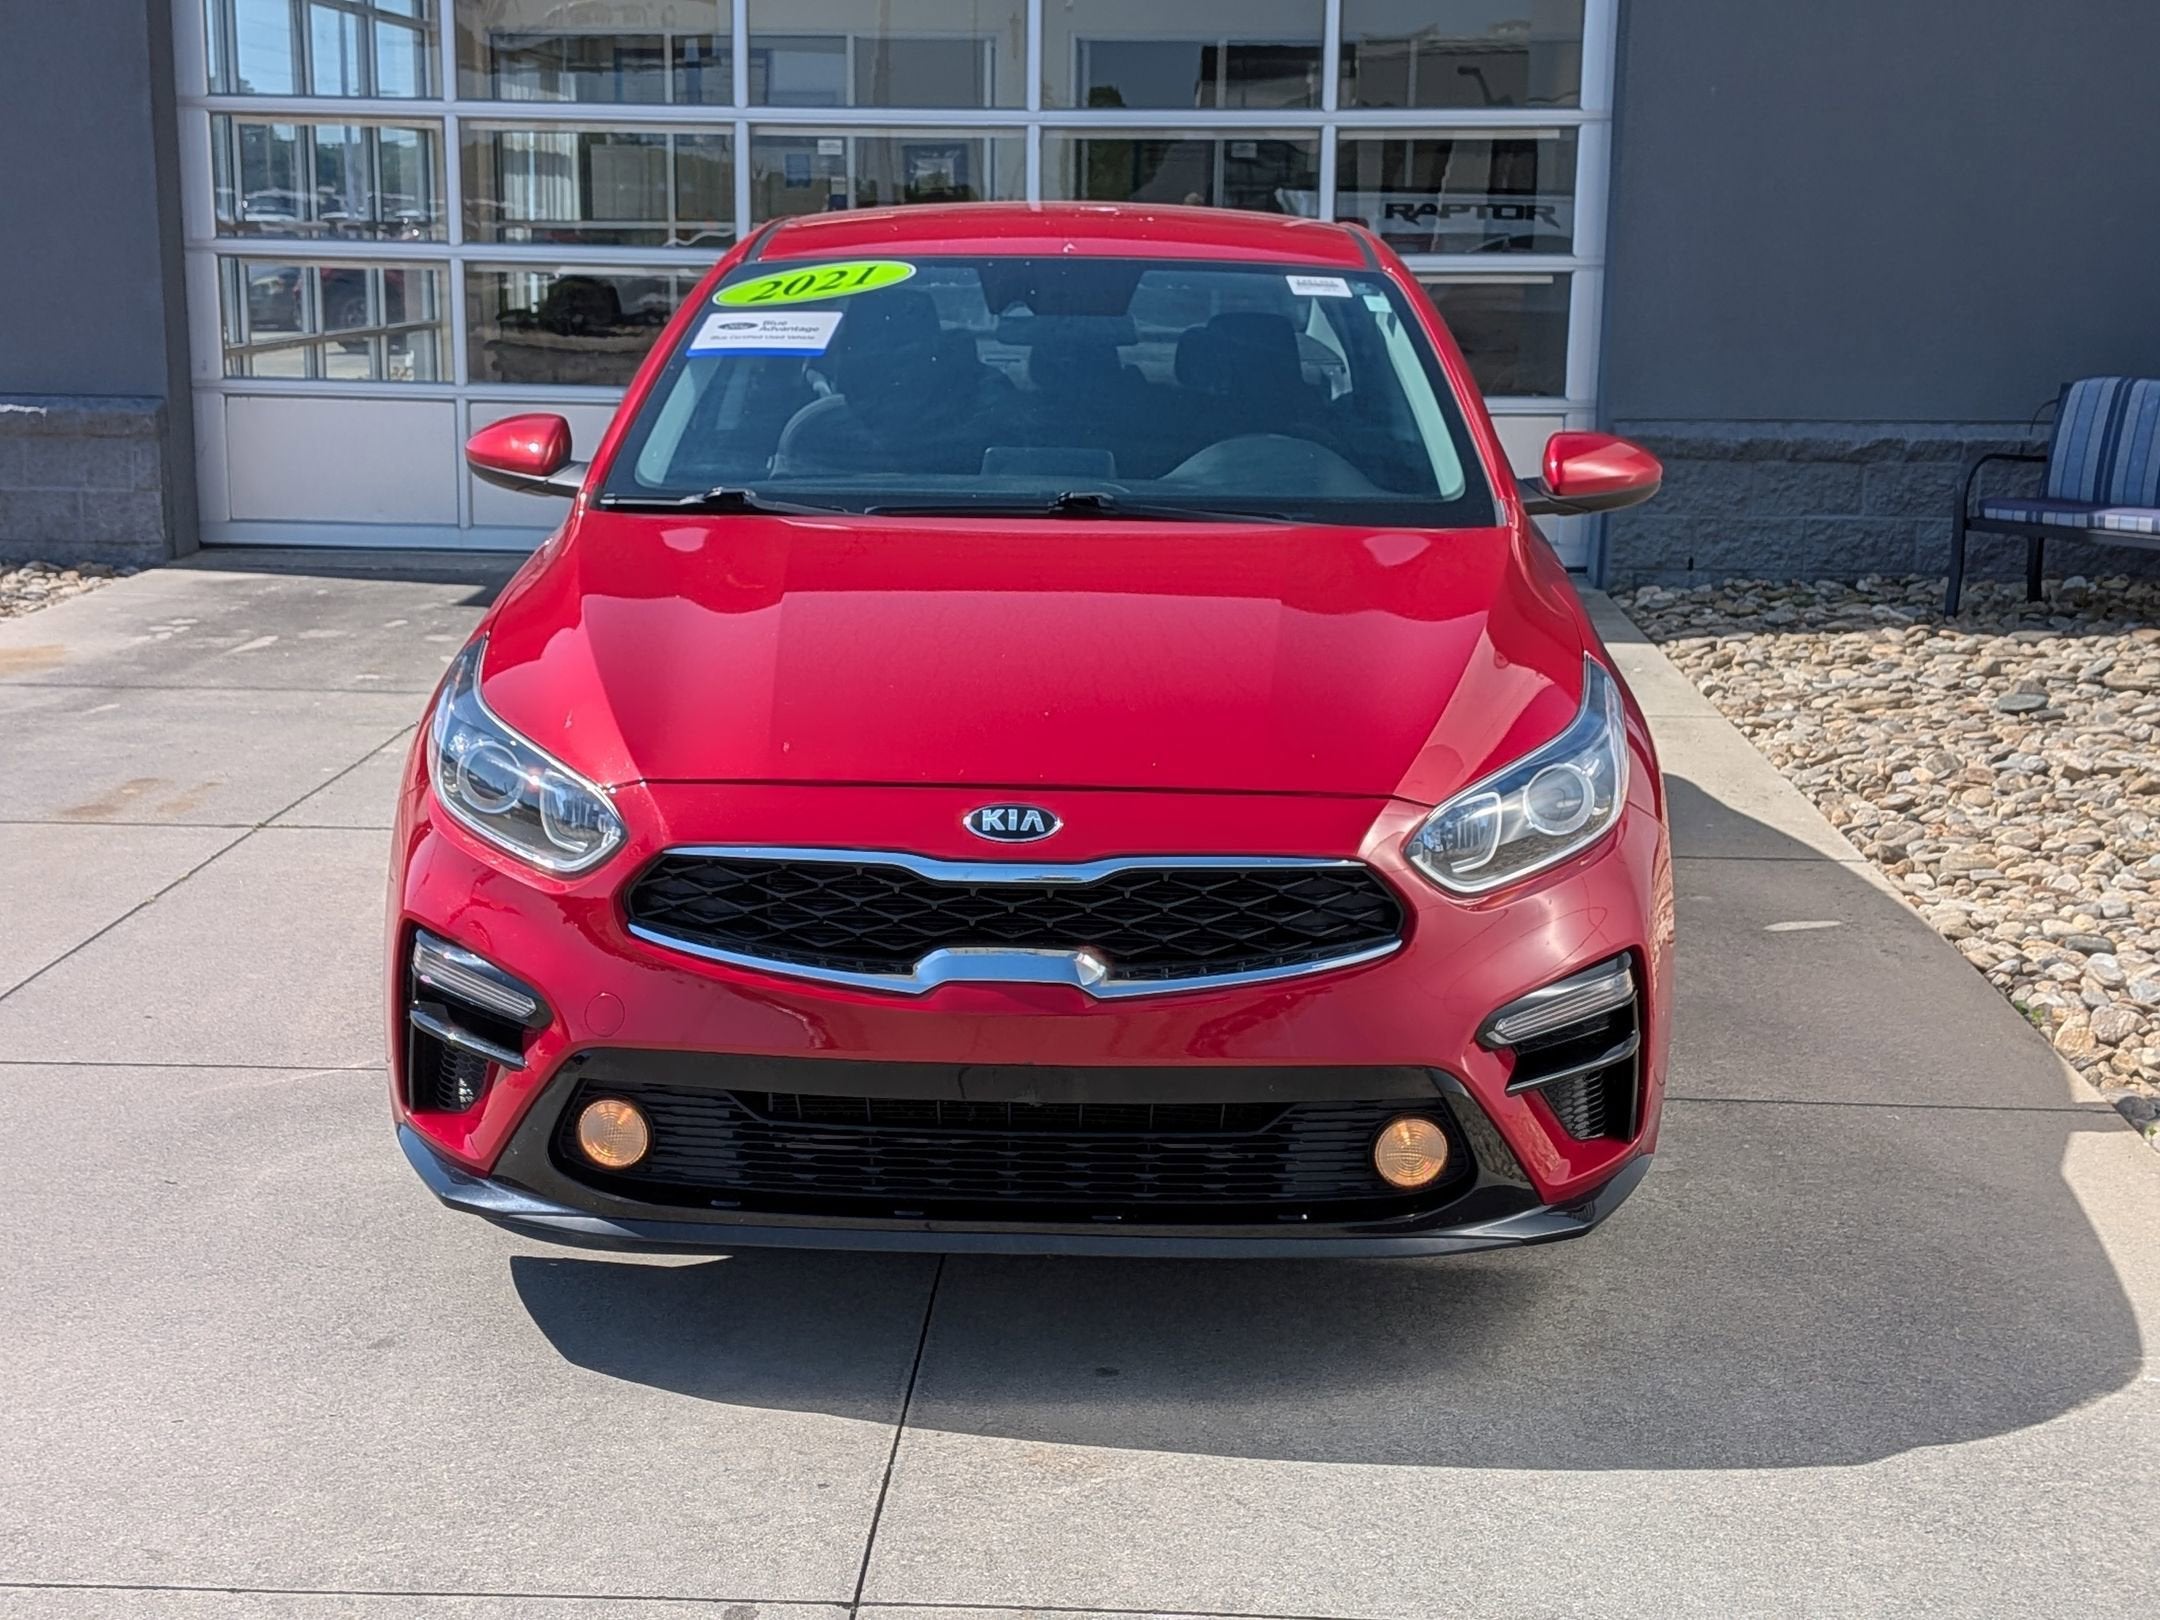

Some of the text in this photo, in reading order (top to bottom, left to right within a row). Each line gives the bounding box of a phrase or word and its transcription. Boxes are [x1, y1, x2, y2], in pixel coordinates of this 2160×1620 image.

[1384, 203, 1560, 229] RAPTOR
[748, 265, 877, 302] 2021
[981, 808, 1045, 832] KIA
